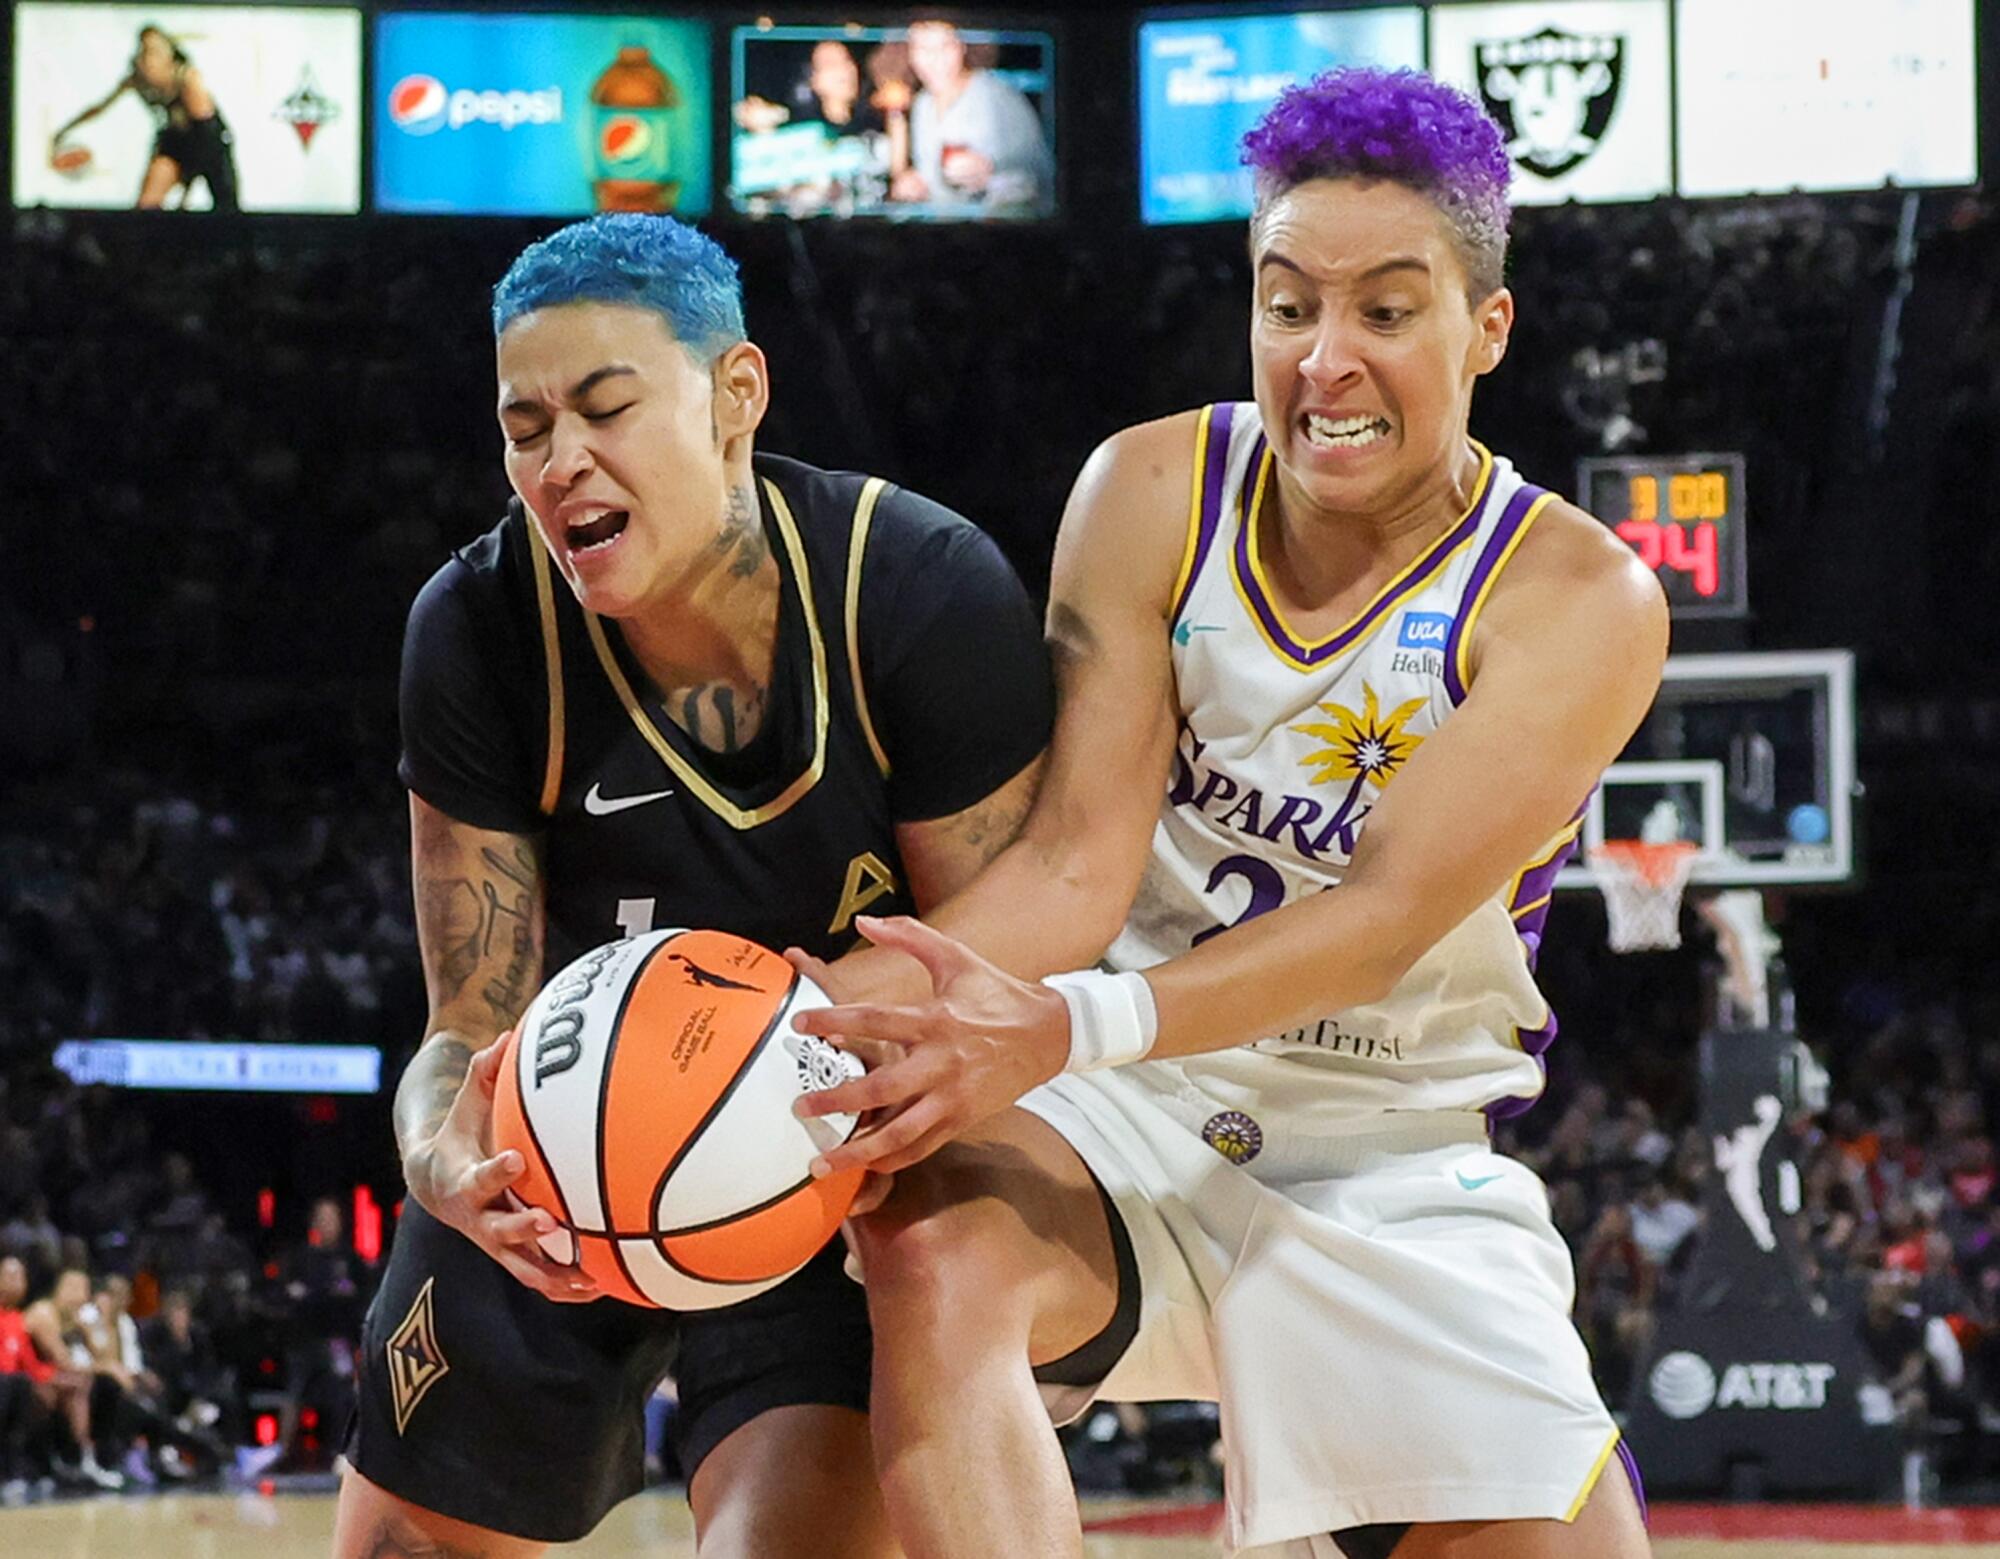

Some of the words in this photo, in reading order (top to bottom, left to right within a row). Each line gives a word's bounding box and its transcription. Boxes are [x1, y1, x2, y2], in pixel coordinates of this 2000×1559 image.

[449, 86, 562, 131] pepsi
[1391, 652, 1442, 679] Helth
[1168, 714, 1372, 862] SPARK
[671, 1007, 703, 1061] OFFICIAL
[679, 1034, 702, 1074] GAME
[696, 1005, 718, 1035] BALL
[1716, 1362, 1837, 1409] AT&T
